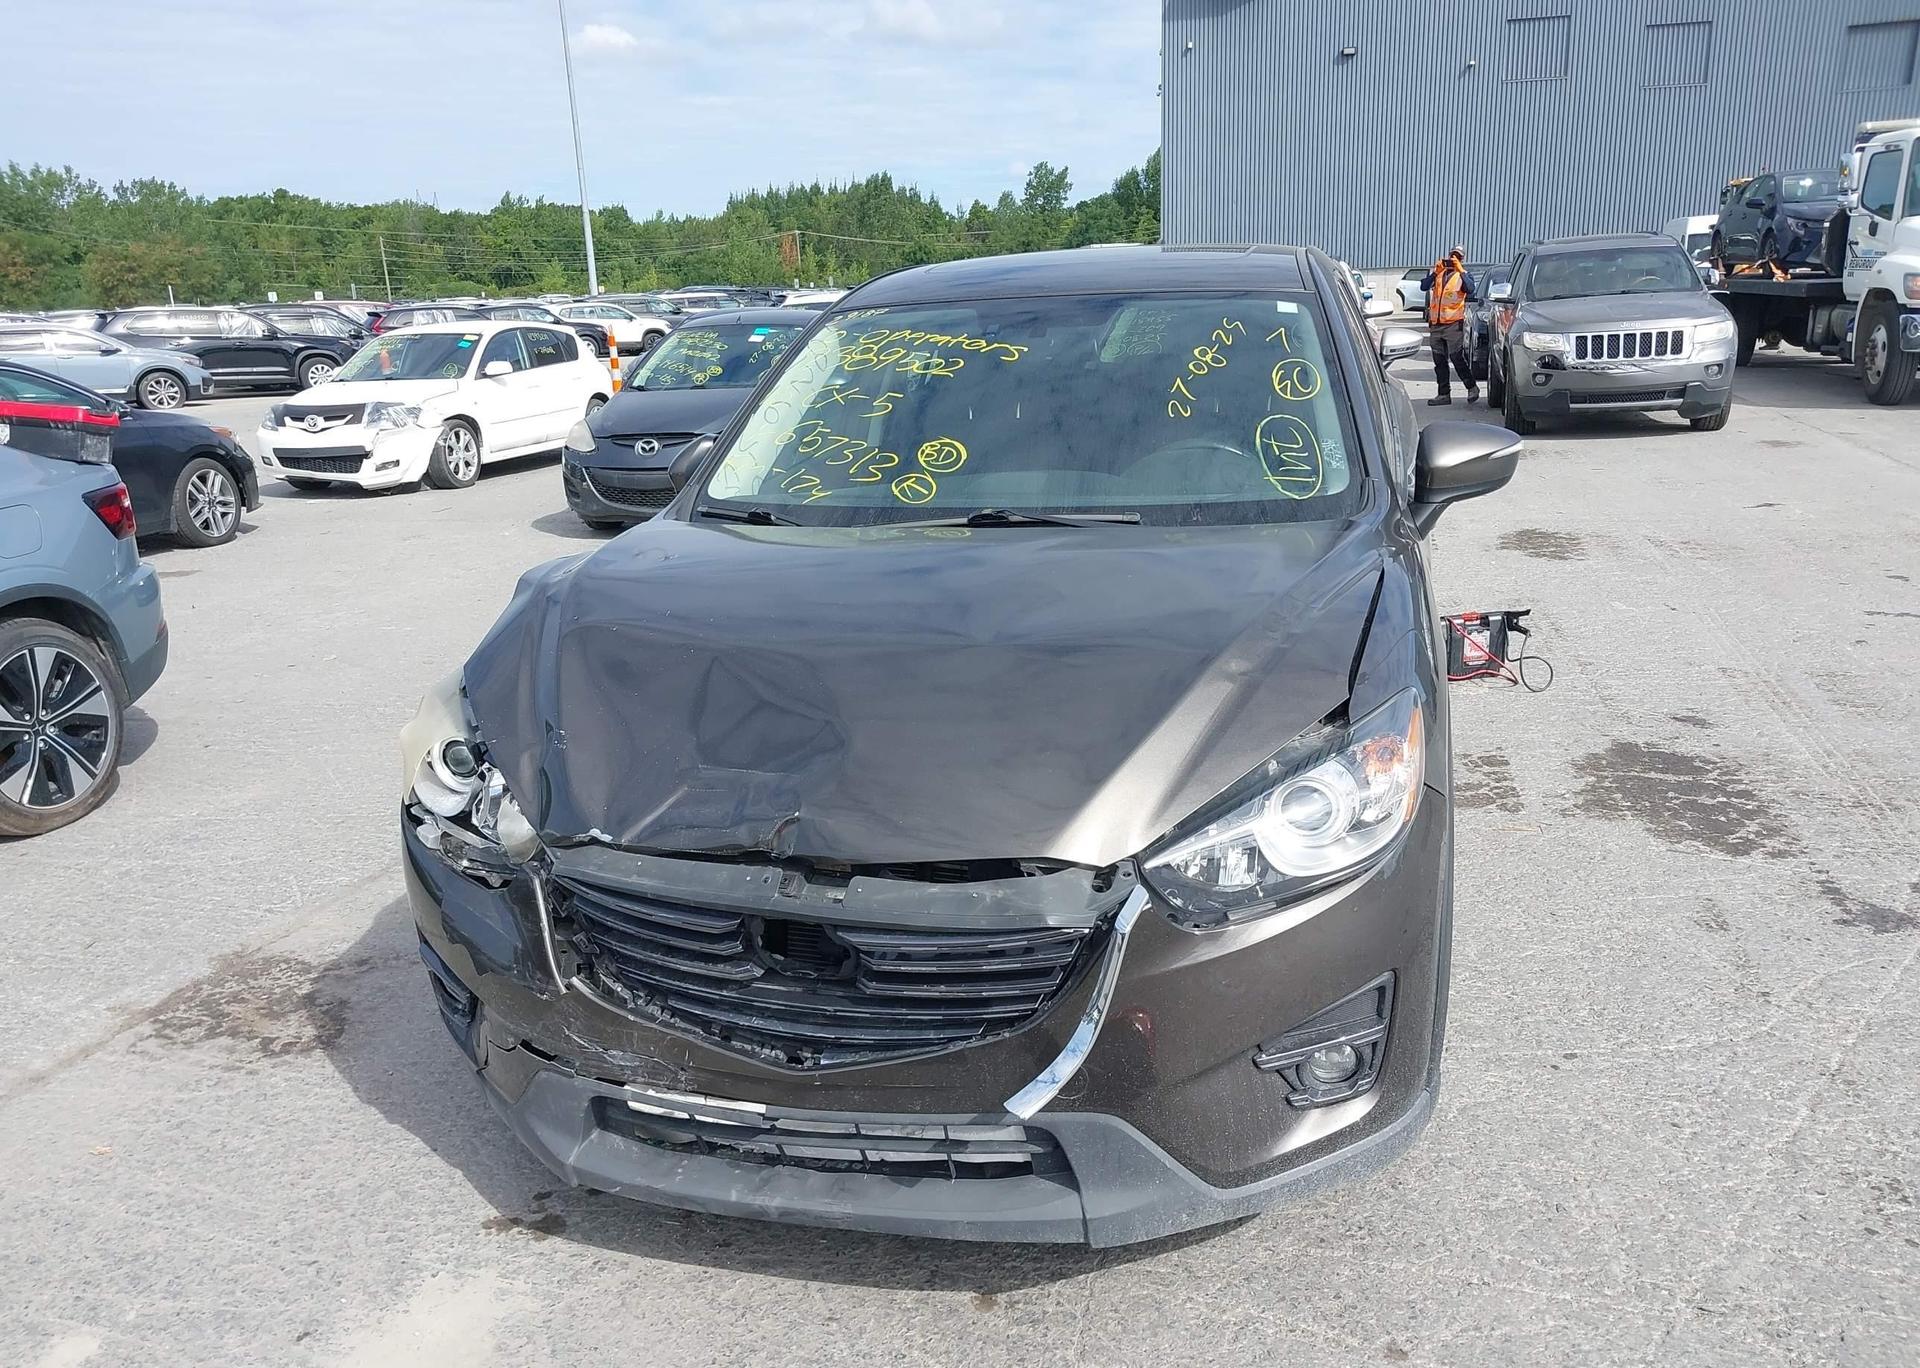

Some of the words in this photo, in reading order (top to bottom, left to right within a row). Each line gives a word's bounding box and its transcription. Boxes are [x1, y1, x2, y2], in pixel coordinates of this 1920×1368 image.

[1620, 321, 1641, 330] Jeep
[775, 420, 900, 482] 657313
[919, 442, 958, 466] BD
[893, 477, 930, 500] K
